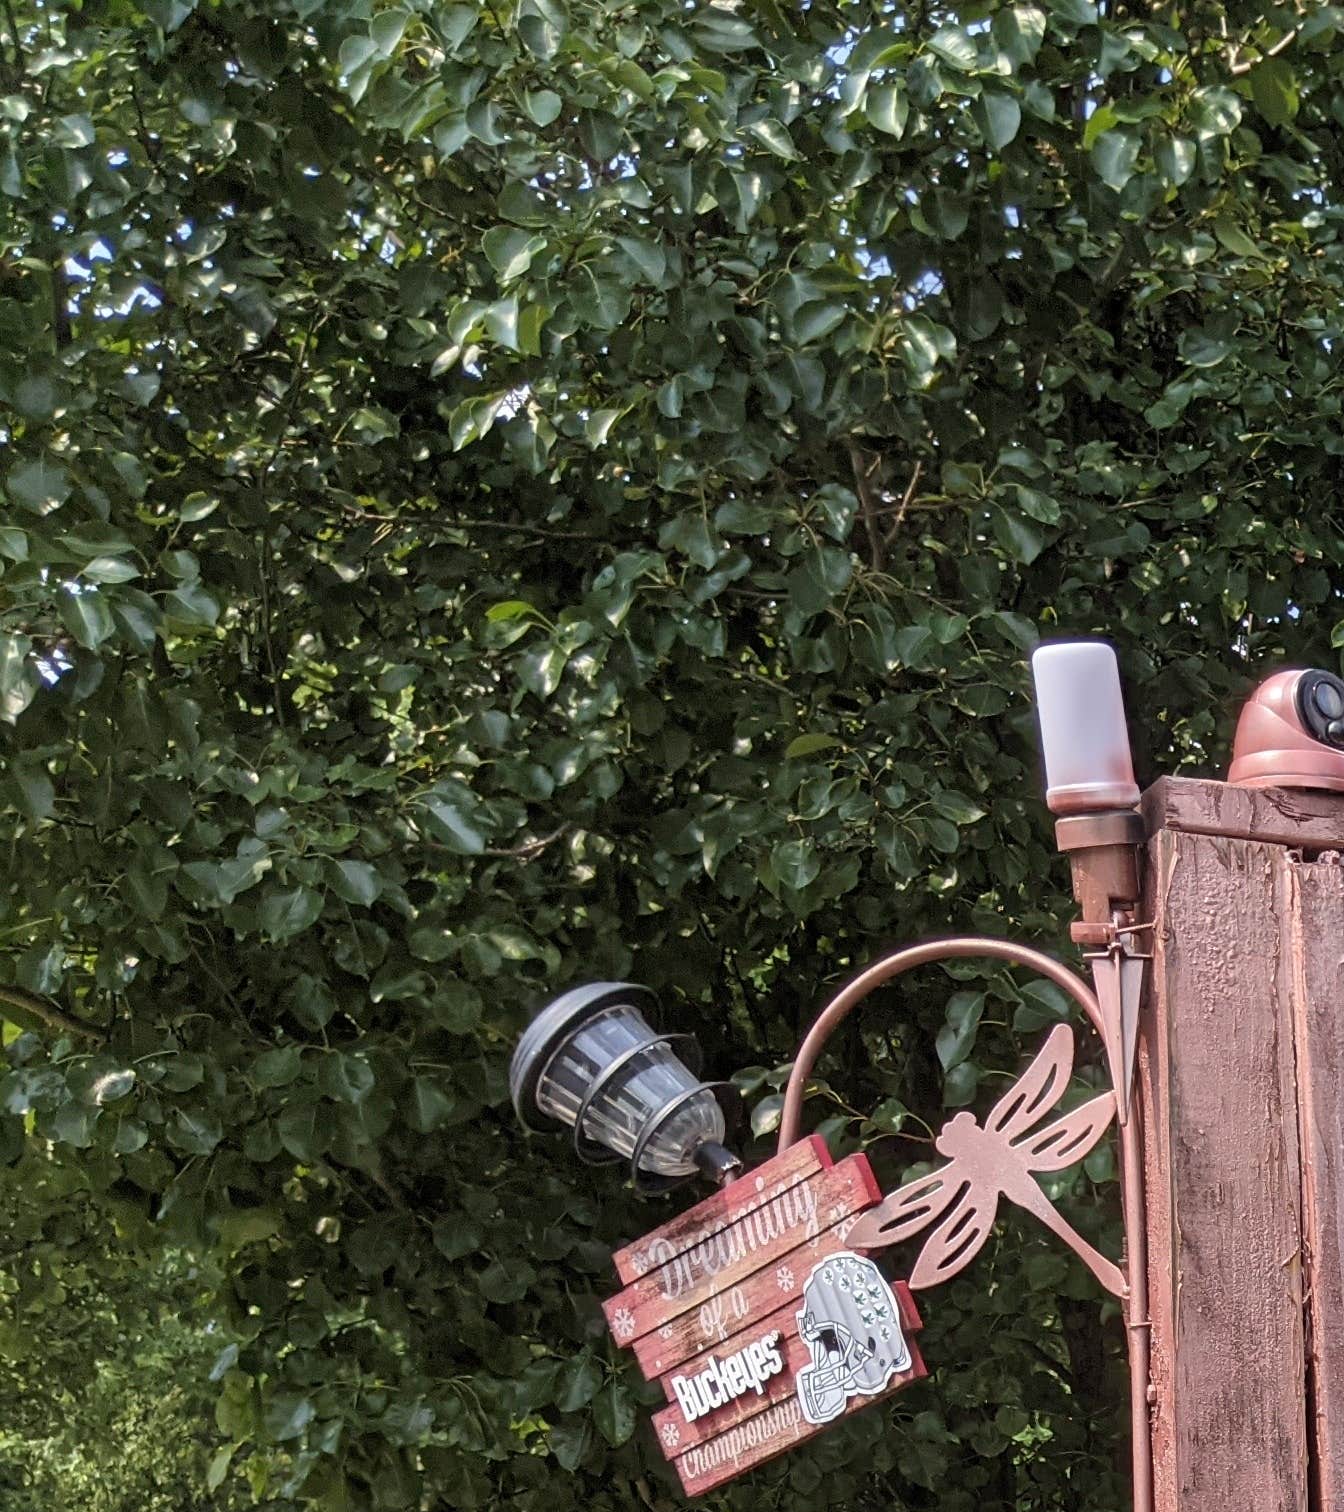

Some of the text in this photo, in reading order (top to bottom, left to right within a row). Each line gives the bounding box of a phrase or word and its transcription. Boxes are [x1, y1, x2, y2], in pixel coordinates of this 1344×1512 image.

[648, 1174, 820, 1300] Dreaming
[700, 1283, 749, 1340] of a
[671, 1332, 782, 1423] Buckeyes
